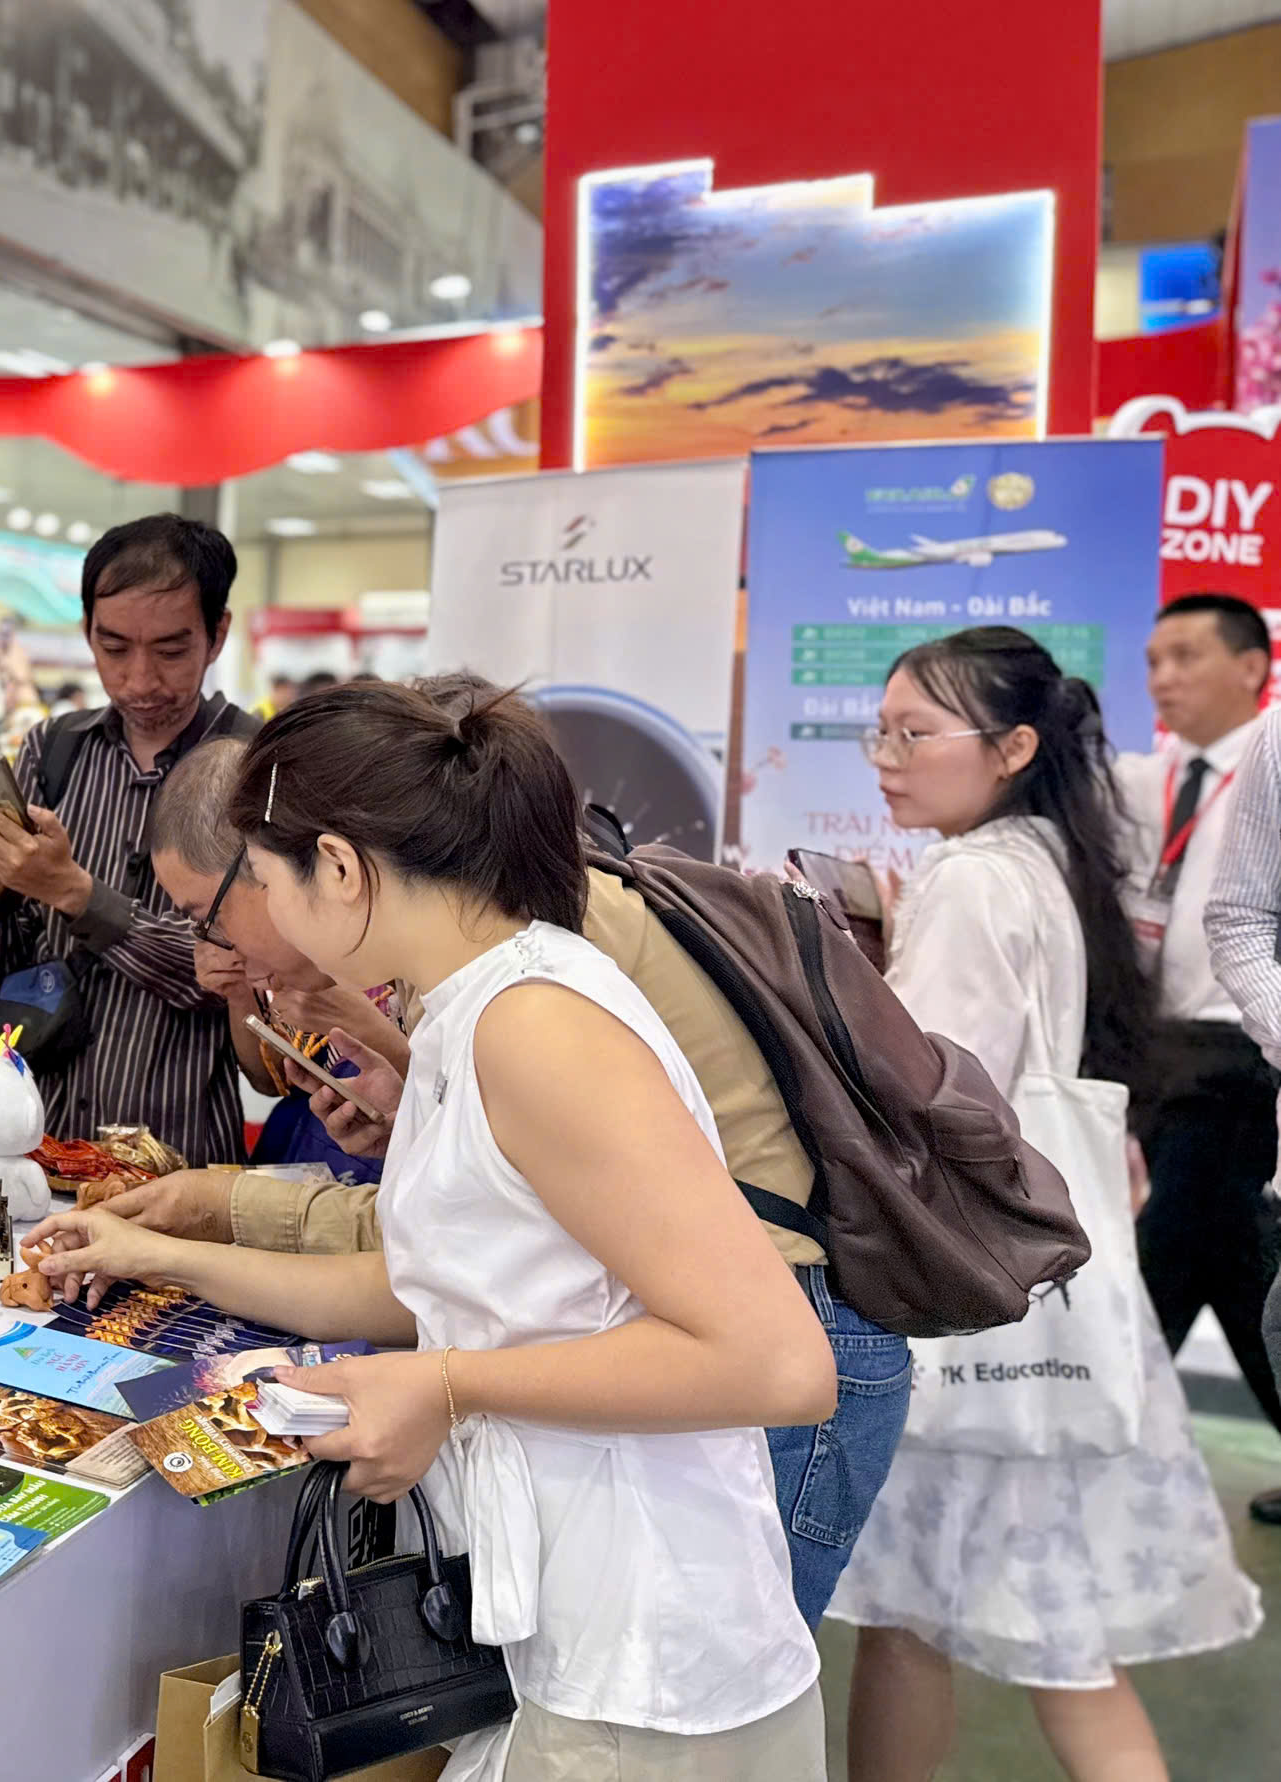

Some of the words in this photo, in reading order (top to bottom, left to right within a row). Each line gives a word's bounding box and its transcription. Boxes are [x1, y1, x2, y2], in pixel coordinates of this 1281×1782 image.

[1164, 475, 1273, 531] DIY
[1161, 530, 1264, 566] ZONE
[500, 555, 653, 587] STARLUX
[847, 596, 890, 619] Việt
[894, 598, 946, 617] Nam
[975, 1358, 1091, 1382] Education
[194, 1414, 223, 1441] Village
[213, 1450, 245, 1480] KIM
[221, 1438, 255, 1474] Carpentry
